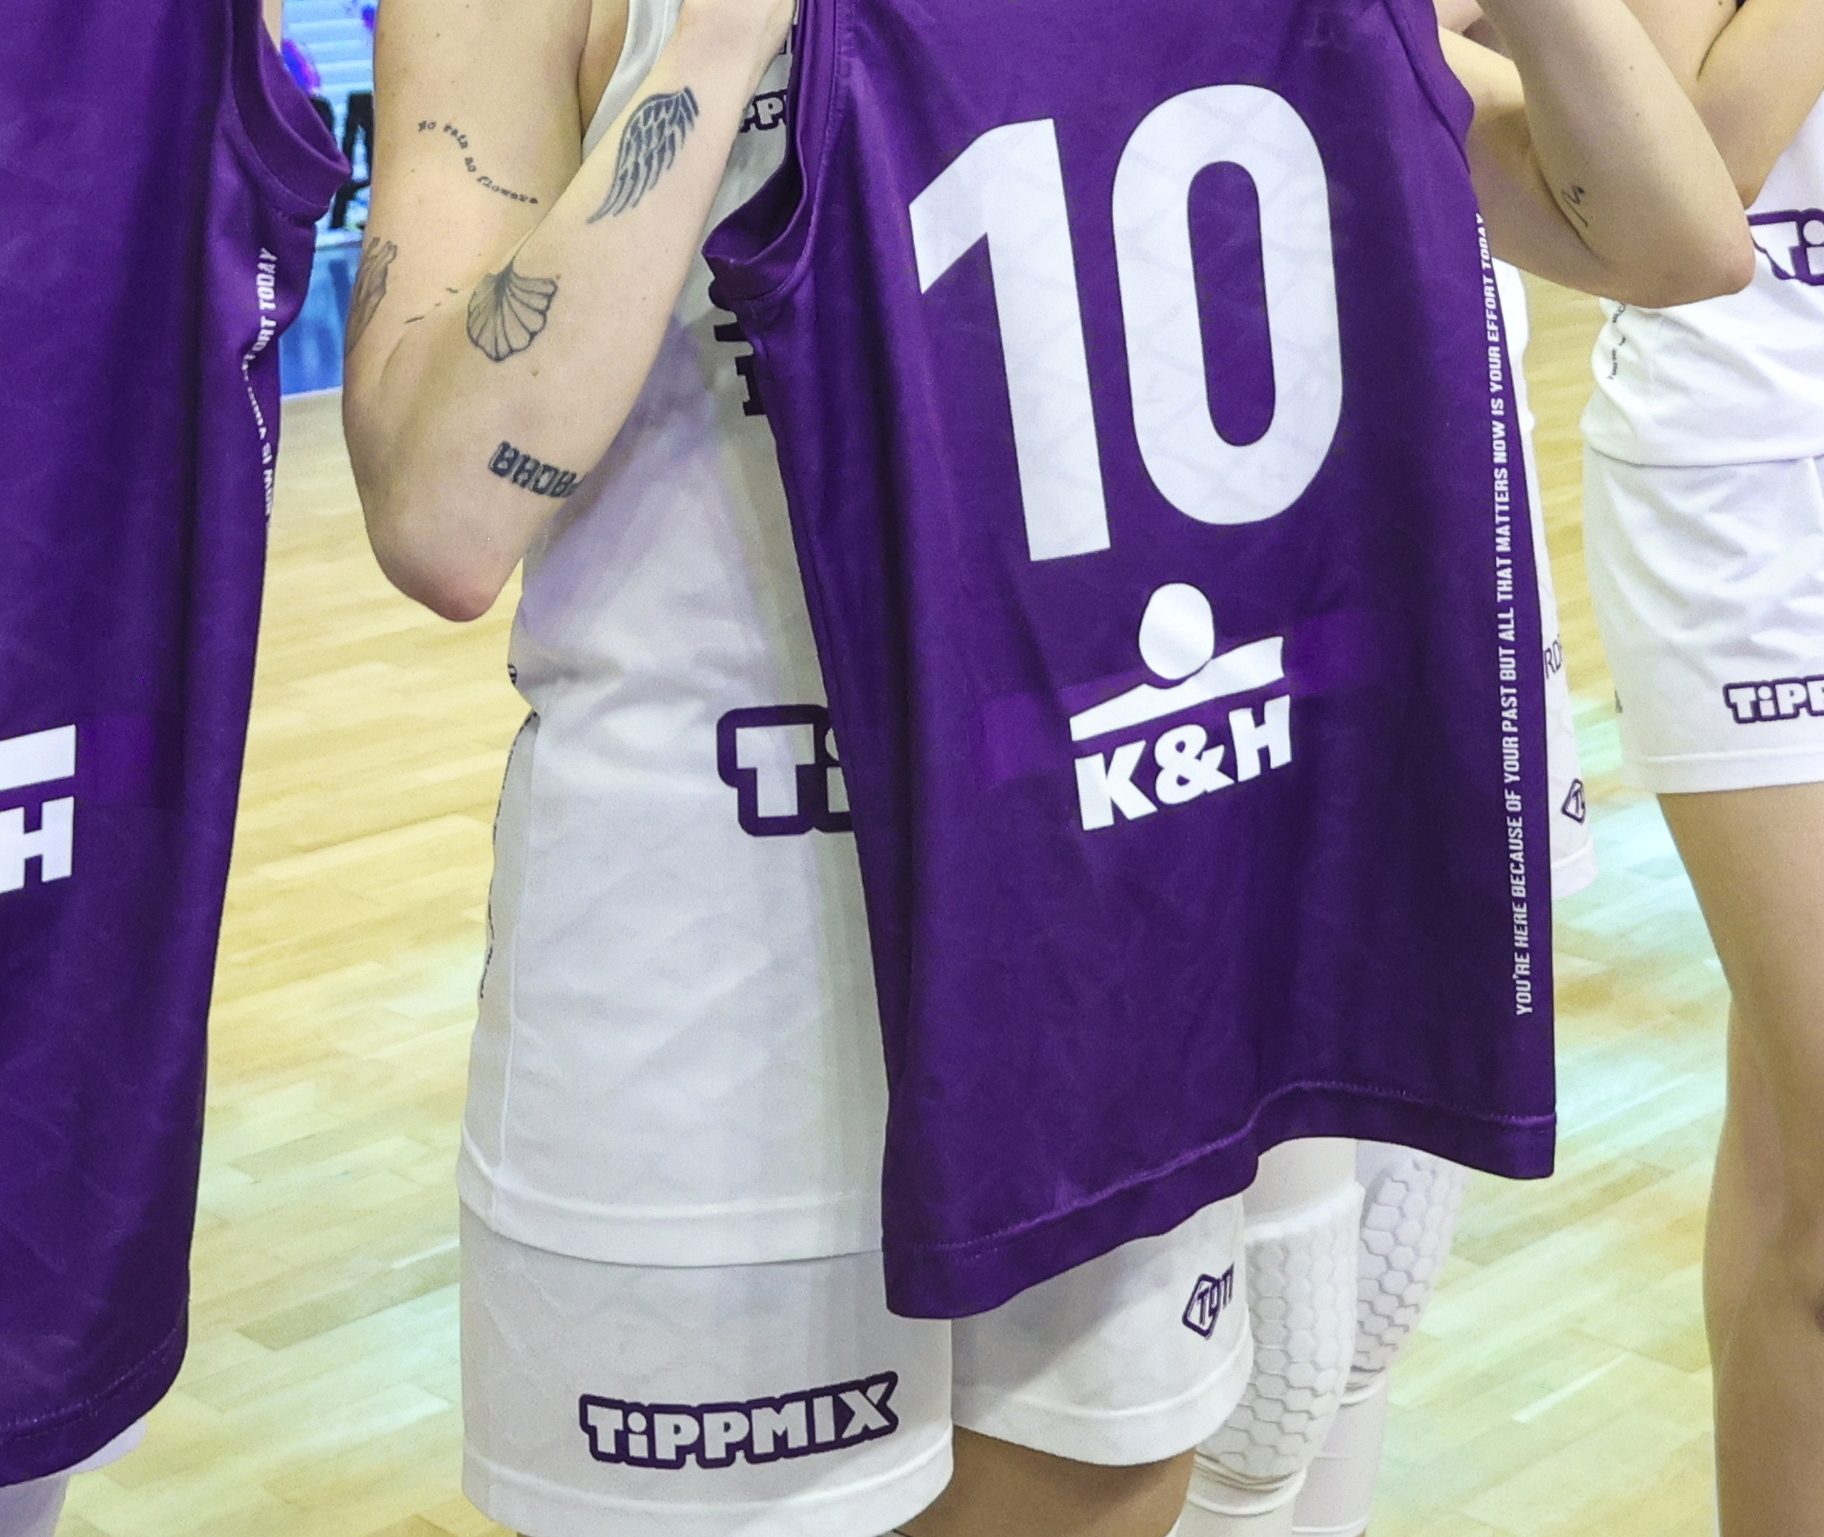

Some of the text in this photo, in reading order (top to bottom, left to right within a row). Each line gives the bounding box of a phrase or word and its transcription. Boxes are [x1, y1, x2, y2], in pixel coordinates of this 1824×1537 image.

[256, 247, 278, 312] TODAY
[908, 83, 1344, 562] 10
[1483, 276, 1502, 343] EFFORT
[1487, 345, 1503, 393] YOUR
[1490, 397, 1505, 416] IS
[1491, 420, 1507, 464] NOW
[1494, 467, 1511, 552] MATTERS
[1495, 556, 1513, 603] THAT
[1497, 607, 1515, 642] ALL
[1498, 646, 1517, 681] BUT
[1500, 685, 1518, 733] PAST
[1073, 694, 1293, 831] K&H
[1502, 736, 1520, 783] YOUR
[1504, 789, 1522, 812] OF
[1507, 816, 1526, 898] BECAUSE
[1512, 902, 1529, 948] HERE
